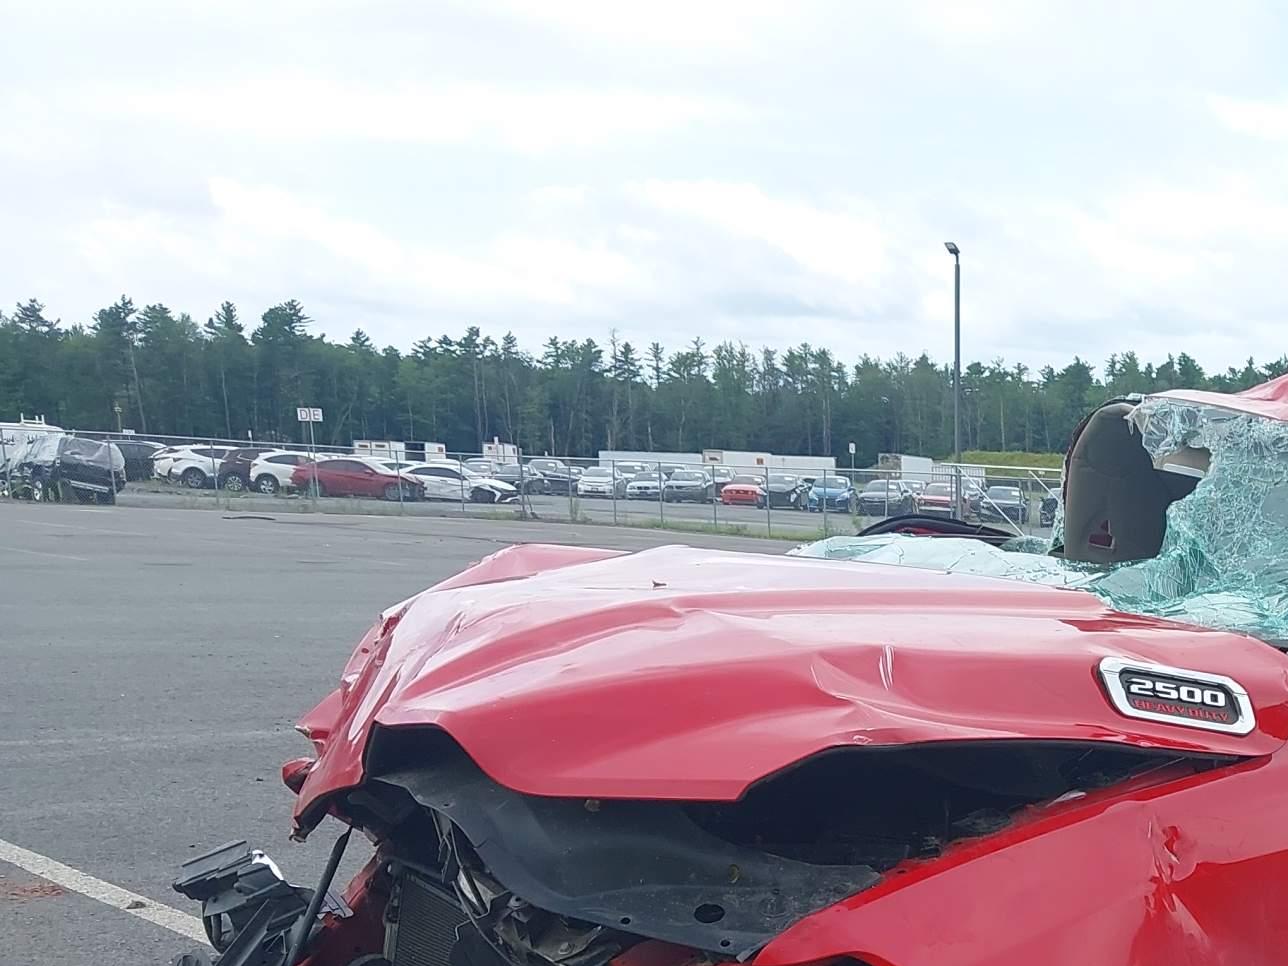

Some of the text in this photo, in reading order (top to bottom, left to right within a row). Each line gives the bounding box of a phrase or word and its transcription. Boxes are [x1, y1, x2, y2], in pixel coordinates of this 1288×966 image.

[1129, 678, 1226, 707] 2500
[1134, 699, 1229, 721] HEAVY DUTY
